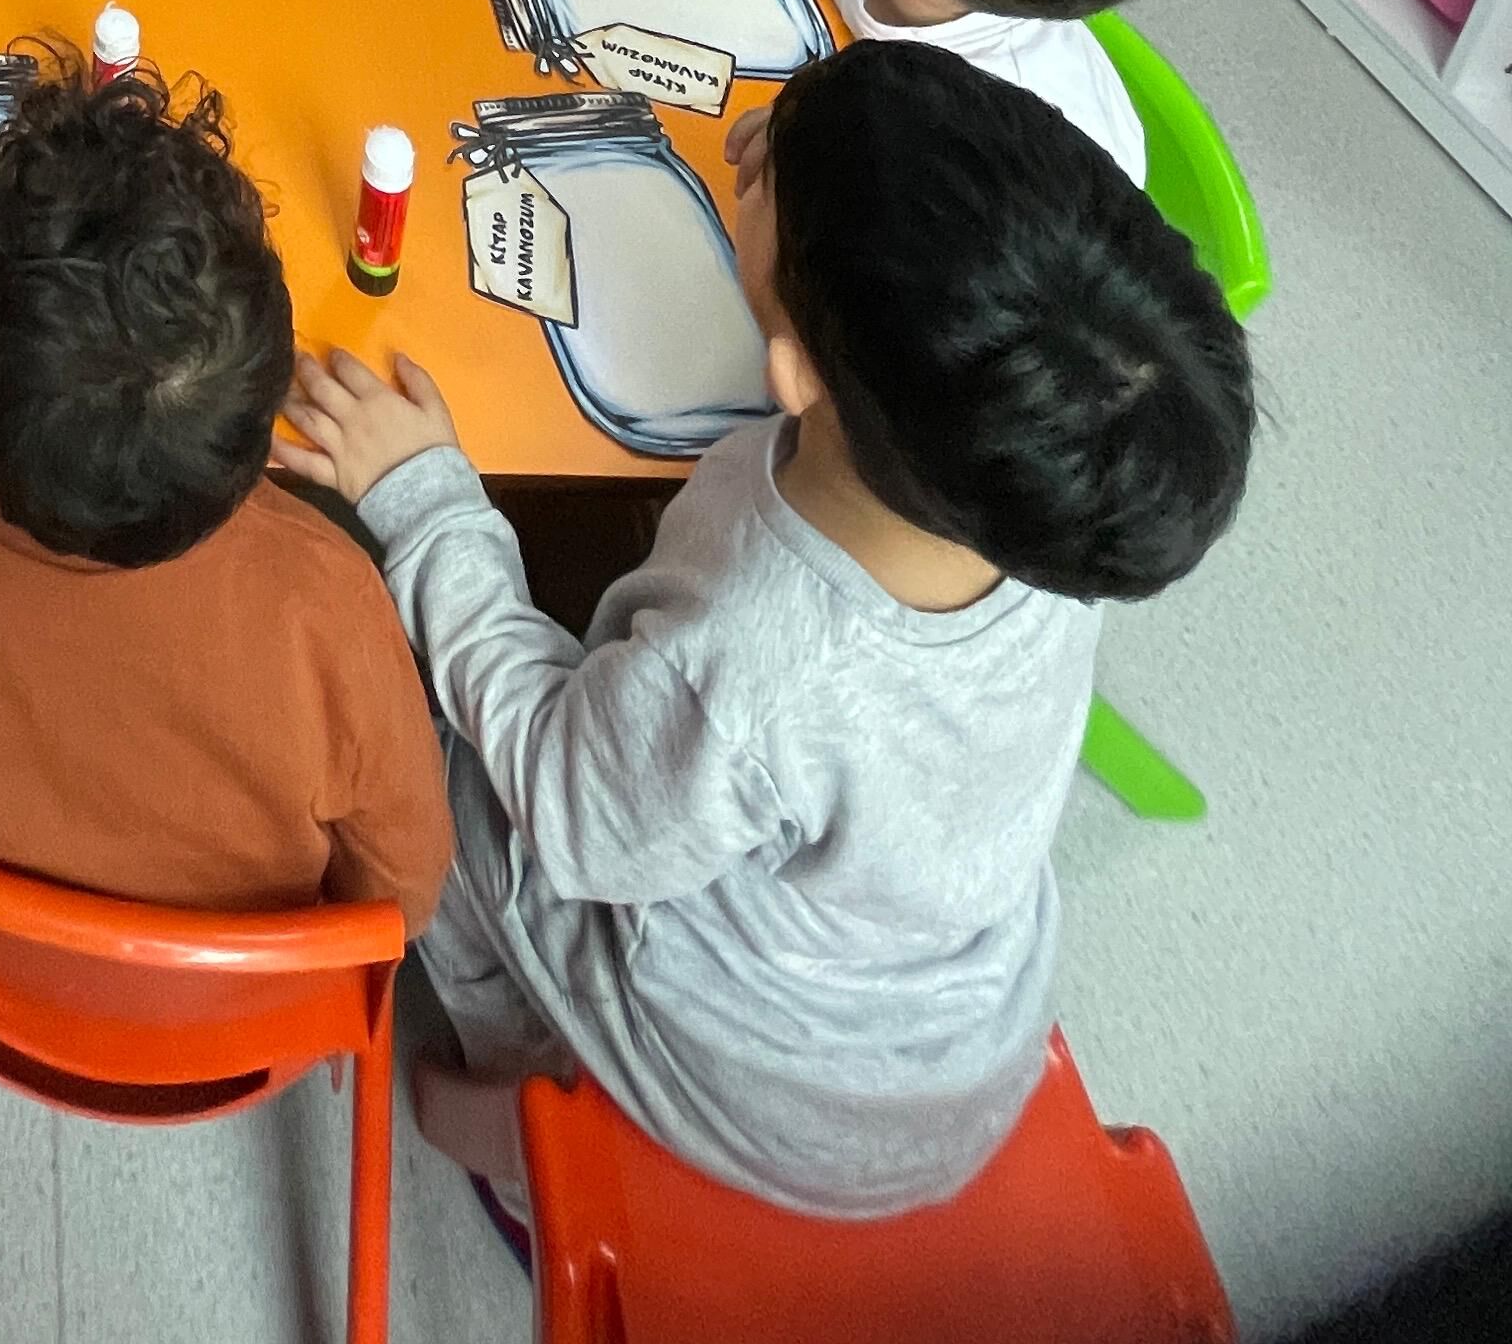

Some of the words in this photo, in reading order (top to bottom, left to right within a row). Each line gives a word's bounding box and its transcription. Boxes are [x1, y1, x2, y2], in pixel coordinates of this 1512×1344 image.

[601, 39, 719, 88] KAVANOZUM
[627, 68, 687, 95] KİTAP
[488, 211, 508, 265] KİTAP
[516, 192, 535, 302] KAVANOZUM
